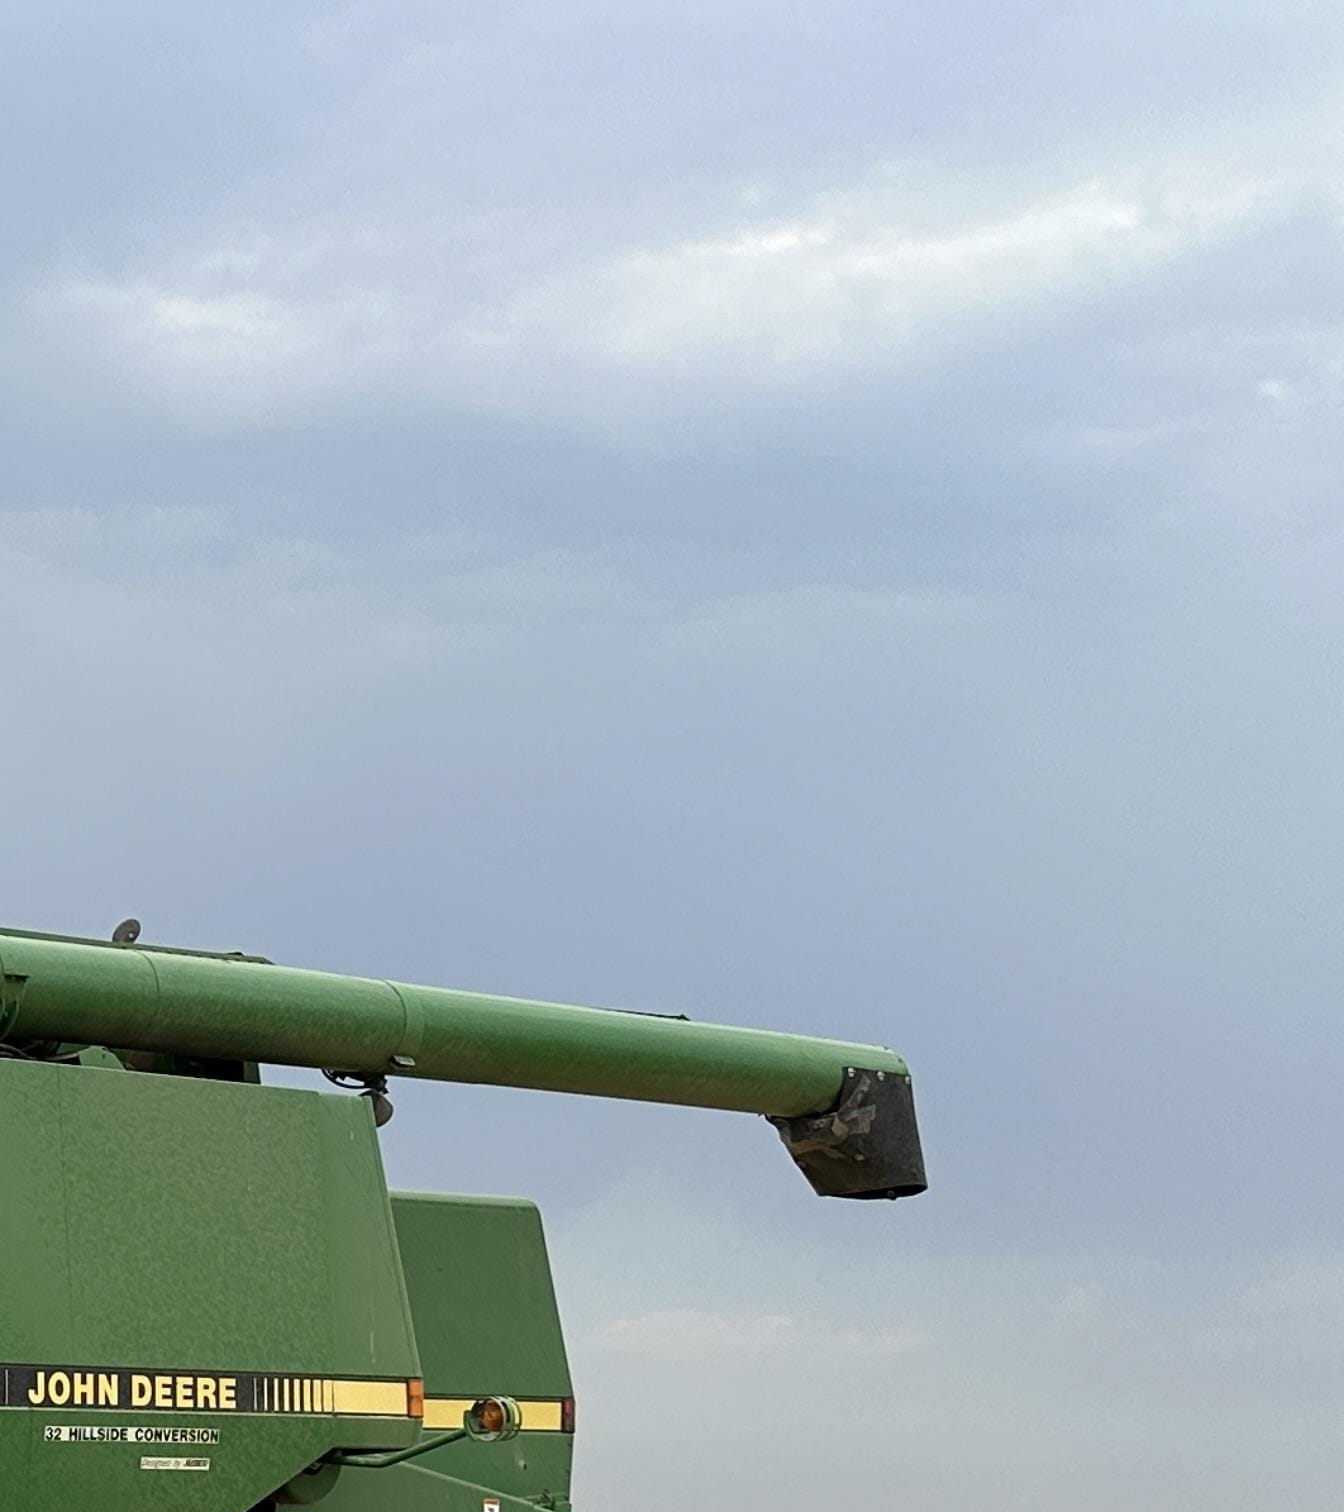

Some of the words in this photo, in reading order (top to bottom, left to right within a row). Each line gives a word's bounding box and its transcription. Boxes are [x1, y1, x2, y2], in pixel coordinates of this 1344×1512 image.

[28, 1371, 119, 1405] JOHN
[131, 1374, 237, 1409] DEERE
[46, 1427, 62, 1440] 32
[69, 1427, 128, 1441] HILLSIDE
[135, 1428, 219, 1443] CONVERSION
